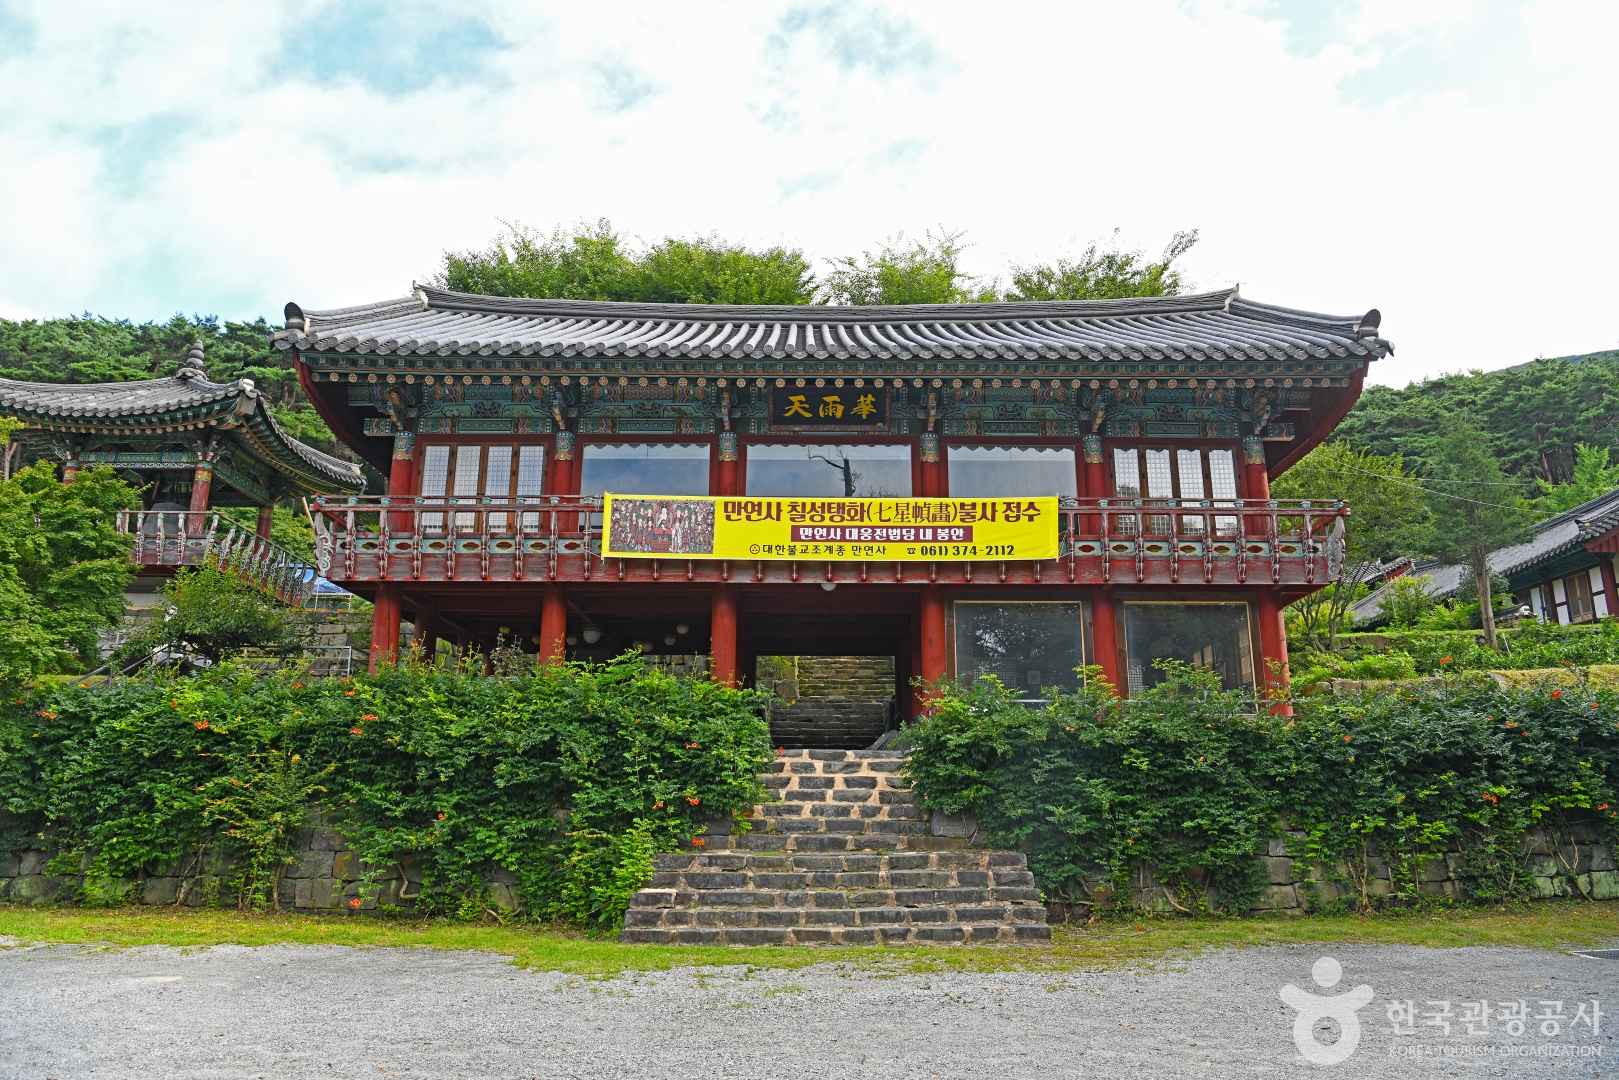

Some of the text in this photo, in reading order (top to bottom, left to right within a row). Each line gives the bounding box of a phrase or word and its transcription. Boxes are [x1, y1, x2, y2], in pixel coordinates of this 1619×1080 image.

[783, 393, 879, 420] 天雨華
[723, 501, 783, 522] 만연사
[1002, 501, 1041, 523] 접수
[799, 527, 965, 541] 만연사 대웅전법당 내 봉안
[762, 544, 887, 557] 대한불교조계종 만연사
[920, 545, 1015, 557] 061) 374-2112
